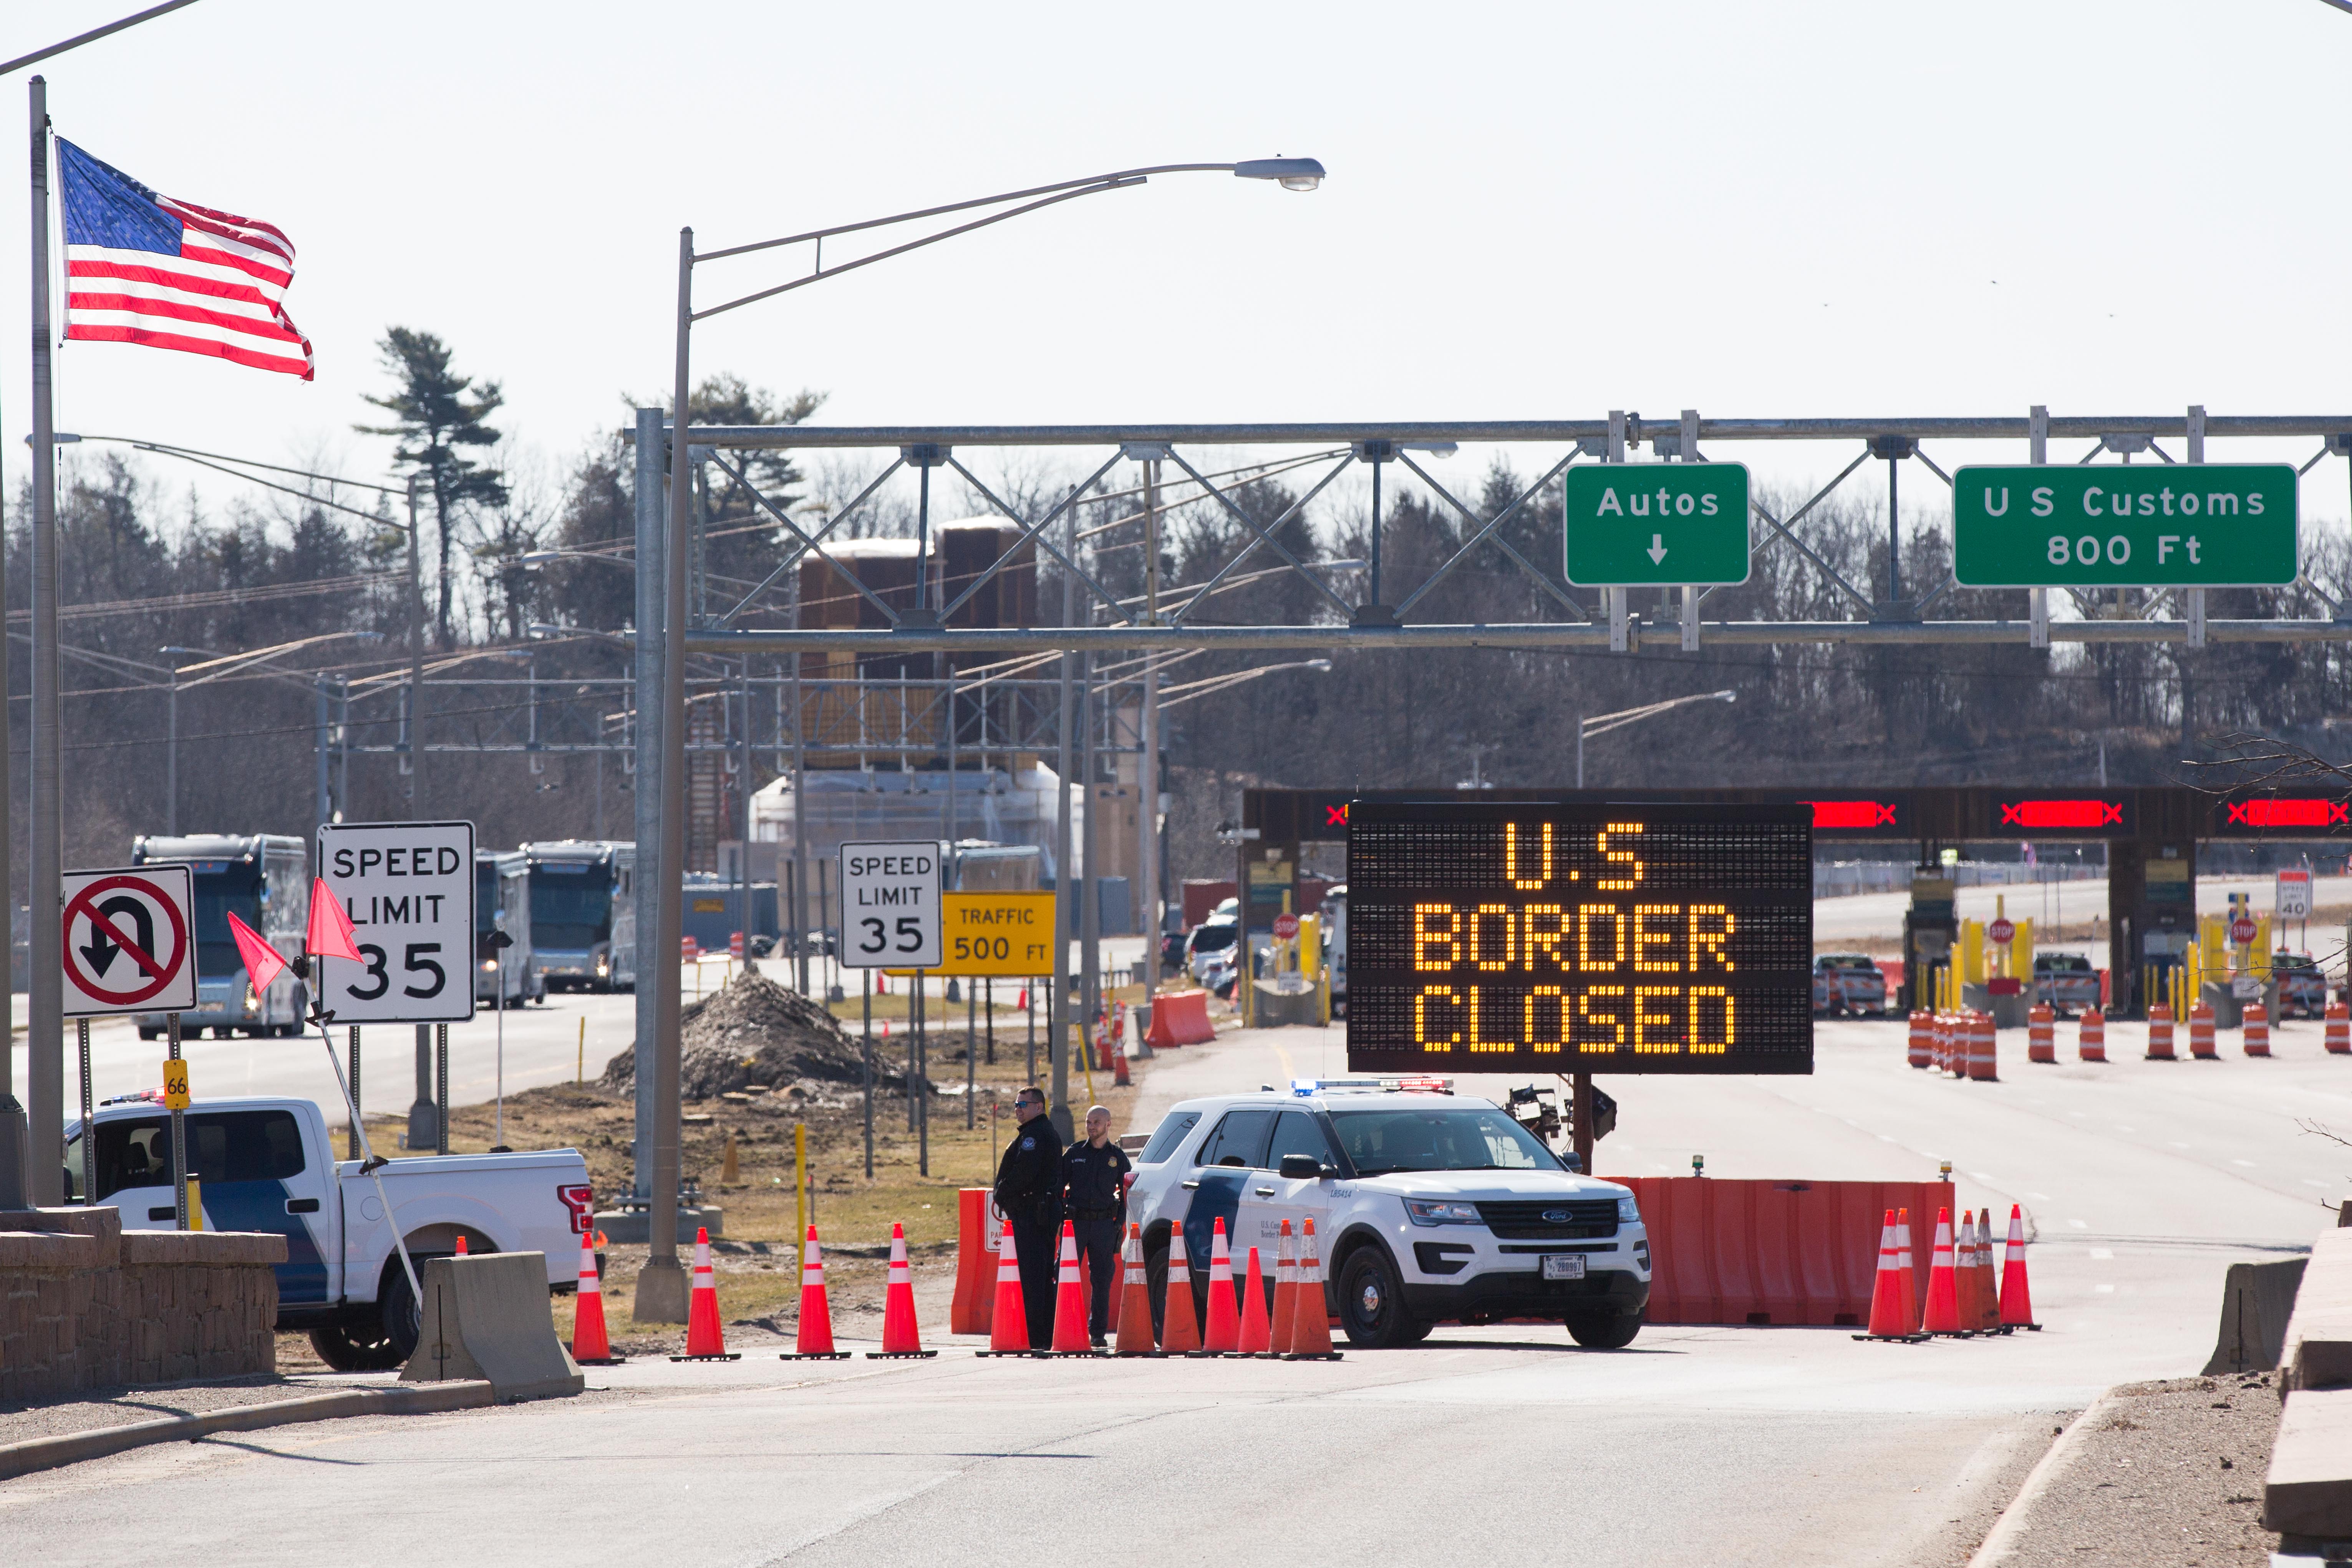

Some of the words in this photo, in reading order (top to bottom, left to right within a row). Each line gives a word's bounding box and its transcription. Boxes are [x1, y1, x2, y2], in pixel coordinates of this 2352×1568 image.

[1597, 488, 1718, 516] Autos
[1985, 488, 2008, 516] U
[2031, 487, 2054, 516] S
[2083, 487, 2264, 515] Customs
[2048, 535, 2130, 564] 800
[2158, 536, 2200, 564] Ft
[333, 847, 460, 878] SPEED
[849, 857, 931, 876] SPEED
[1506, 823, 1644, 890] U.S
[859, 887, 923, 905] LIMIT
[347, 895, 445, 925] LIMIT
[960, 908, 1034, 925] TRAFFIC
[2282, 903, 2304, 914] 40
[859, 917, 923, 954] 35
[1275, 922, 1298, 931] STOP
[1415, 904, 1735, 972] BORDER
[1991, 925, 2014, 938] STOP
[2233, 925, 2256, 938] STOP
[955, 937, 1010, 960] 500
[1026, 944, 1047, 961] FT
[346, 943, 446, 1001] 35
[1415, 985, 1735, 1054] CLOSED
[167, 1077, 187, 1095] 66
[1330, 1189, 1352, 1198] L85414
[1261, 1230, 1275, 1238] Border
